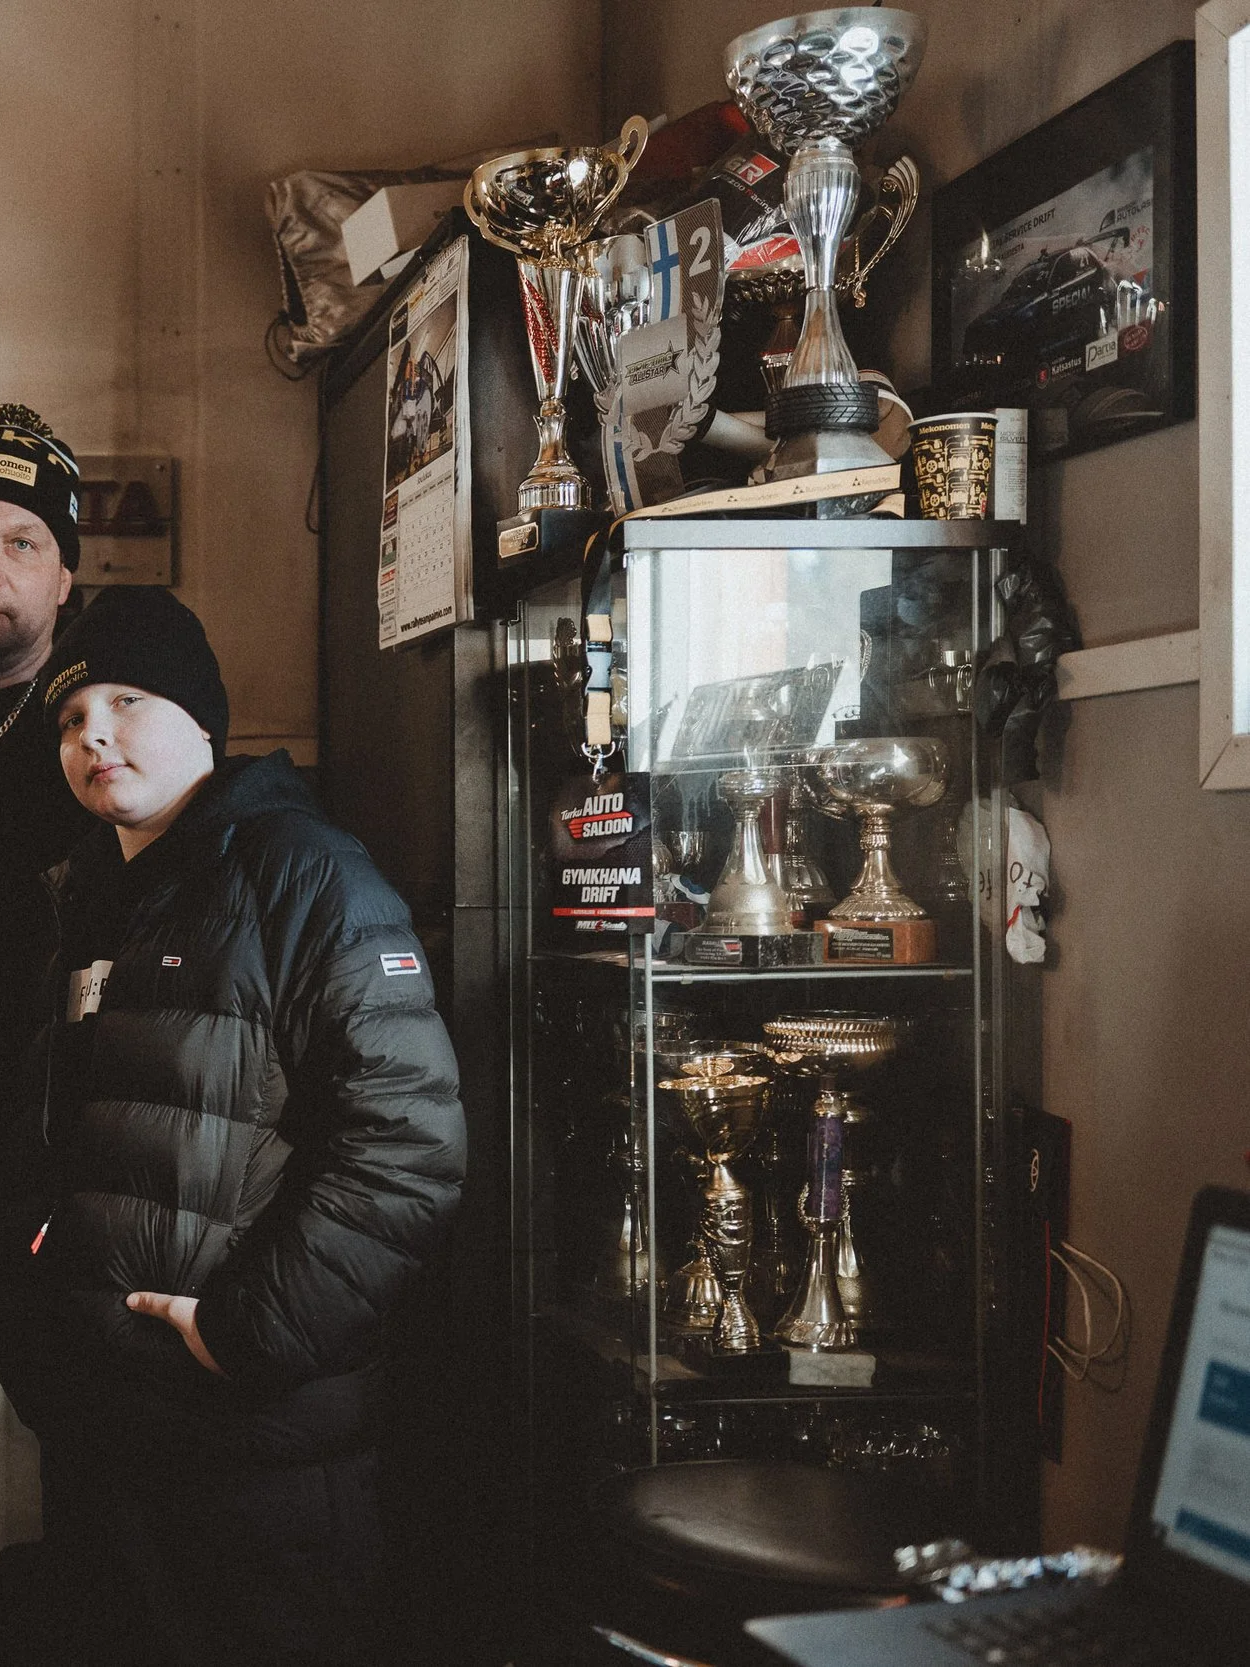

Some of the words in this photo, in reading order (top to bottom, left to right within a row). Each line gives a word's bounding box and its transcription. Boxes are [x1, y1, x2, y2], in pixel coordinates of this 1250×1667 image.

[1033, 207, 1056, 228] DRIFT
[688, 226, 712, 278] 2
[631, 366, 665, 384] ALLSTAR
[919, 422, 970, 435] Mekonomen
[582, 792, 624, 817] AUTO
[582, 816, 633, 838] SALOON
[562, 867, 642, 885] GYMKHANA
[581, 886, 620, 903] DRIFT
